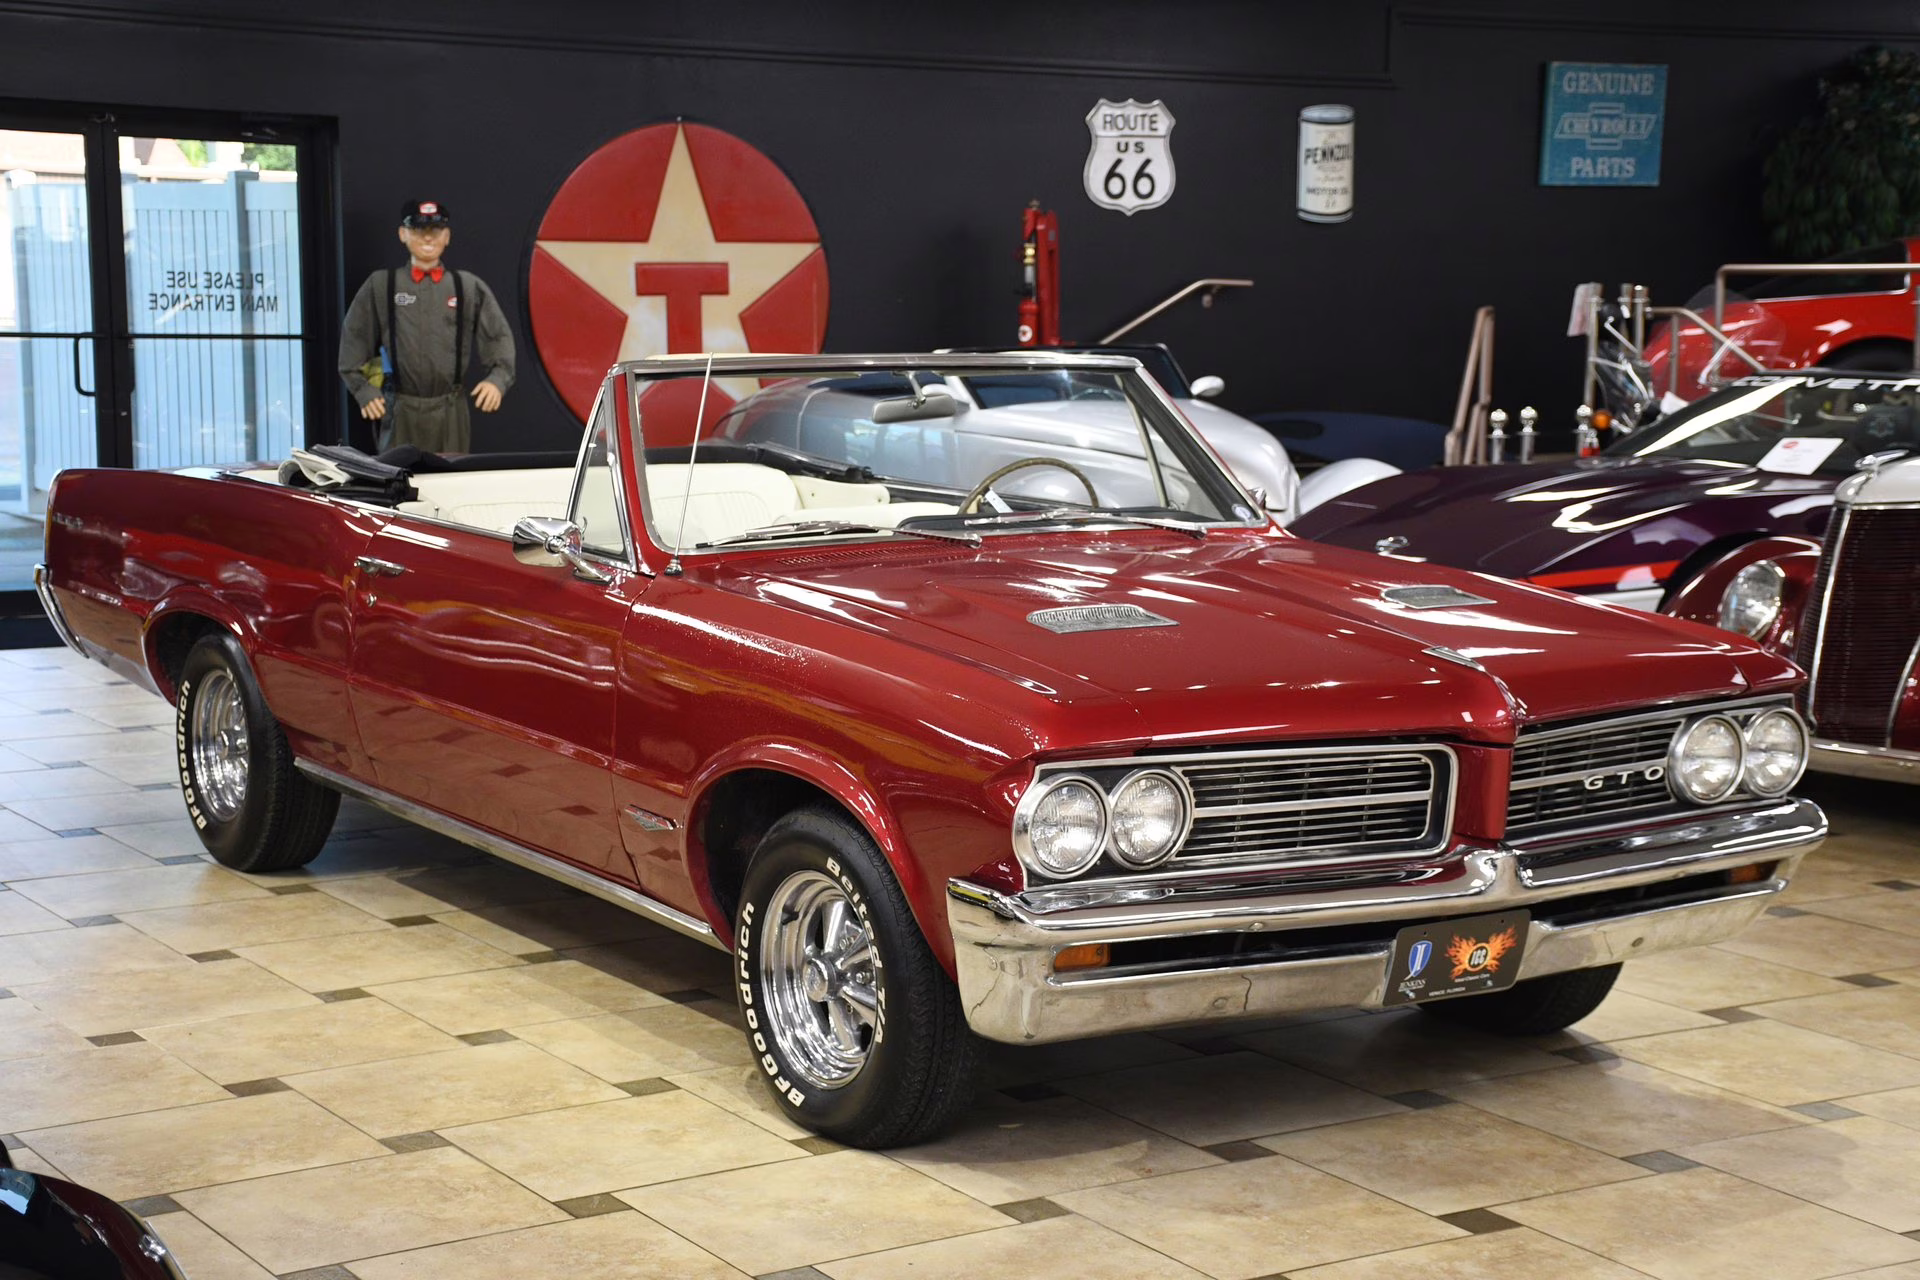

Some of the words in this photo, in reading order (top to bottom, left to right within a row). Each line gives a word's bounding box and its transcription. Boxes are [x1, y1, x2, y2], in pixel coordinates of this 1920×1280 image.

[1562, 71, 1656, 96] GENUINE
[1102, 112, 1159, 131] ROUTE
[1116, 140, 1145, 154] US
[1103, 157, 1156, 200] 66
[1569, 156, 1637, 179] PARTS
[634, 261, 730, 355] T
[176, 679, 208, 830] BFGoodrich
[1583, 765, 1665, 791] GTO
[825, 856, 883, 970] Belted
[875, 986, 885, 1043] T/A
[737, 901, 806, 1108] BFGoodrich
